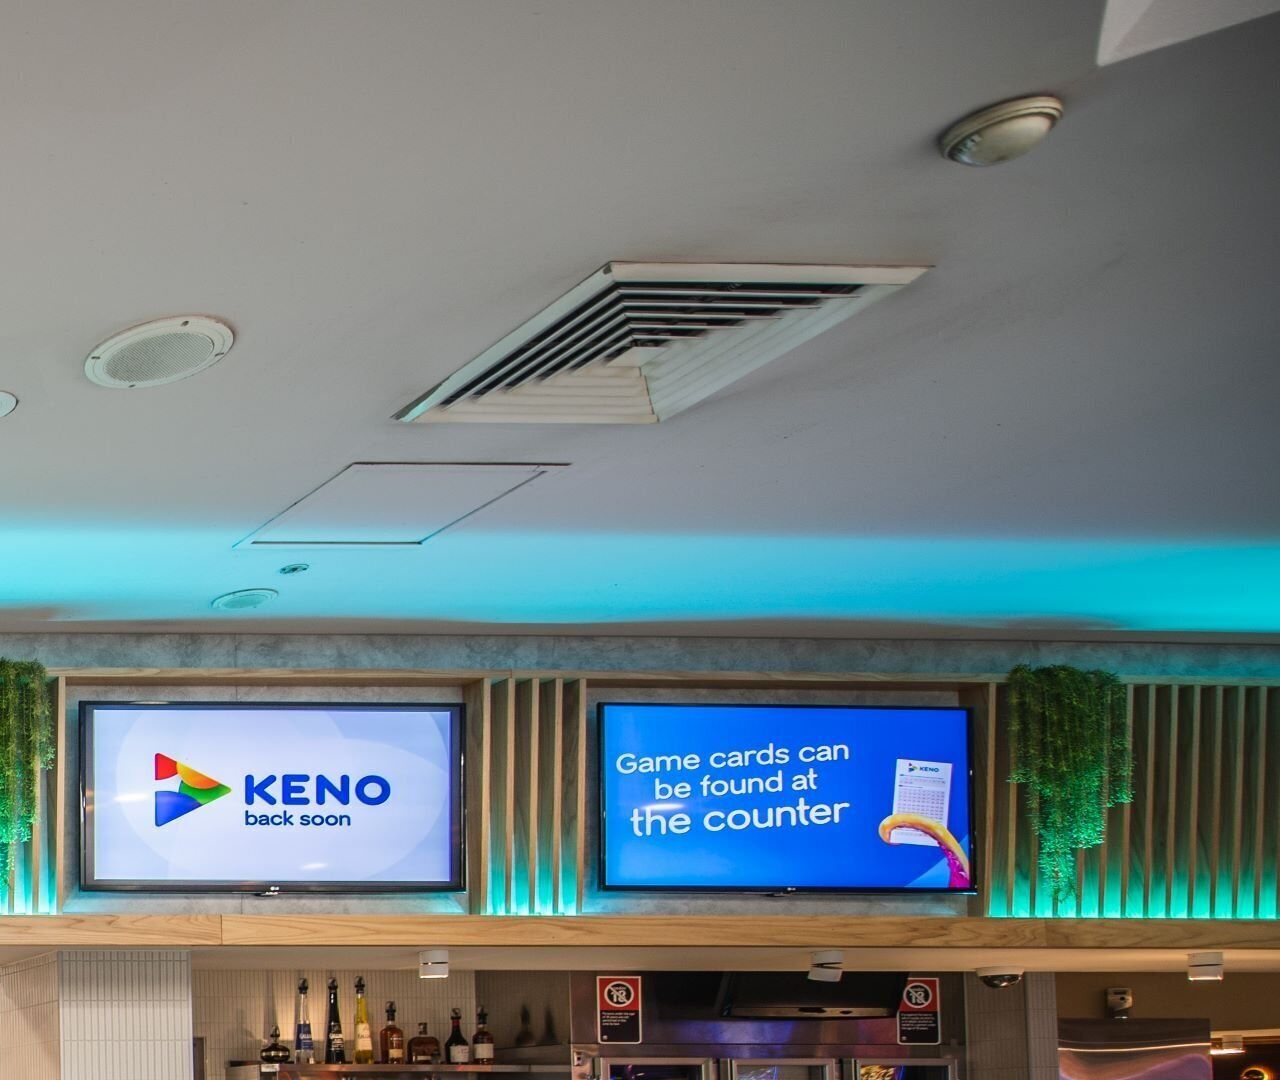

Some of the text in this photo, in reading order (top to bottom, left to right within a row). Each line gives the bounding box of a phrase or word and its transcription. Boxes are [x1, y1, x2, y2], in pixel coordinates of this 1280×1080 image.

[615, 743, 850, 775] Game cards can
[244, 774, 391, 806] KENO
[654, 768, 818, 800] be found at
[244, 810, 351, 827] back soon
[630, 798, 851, 838] the counter
